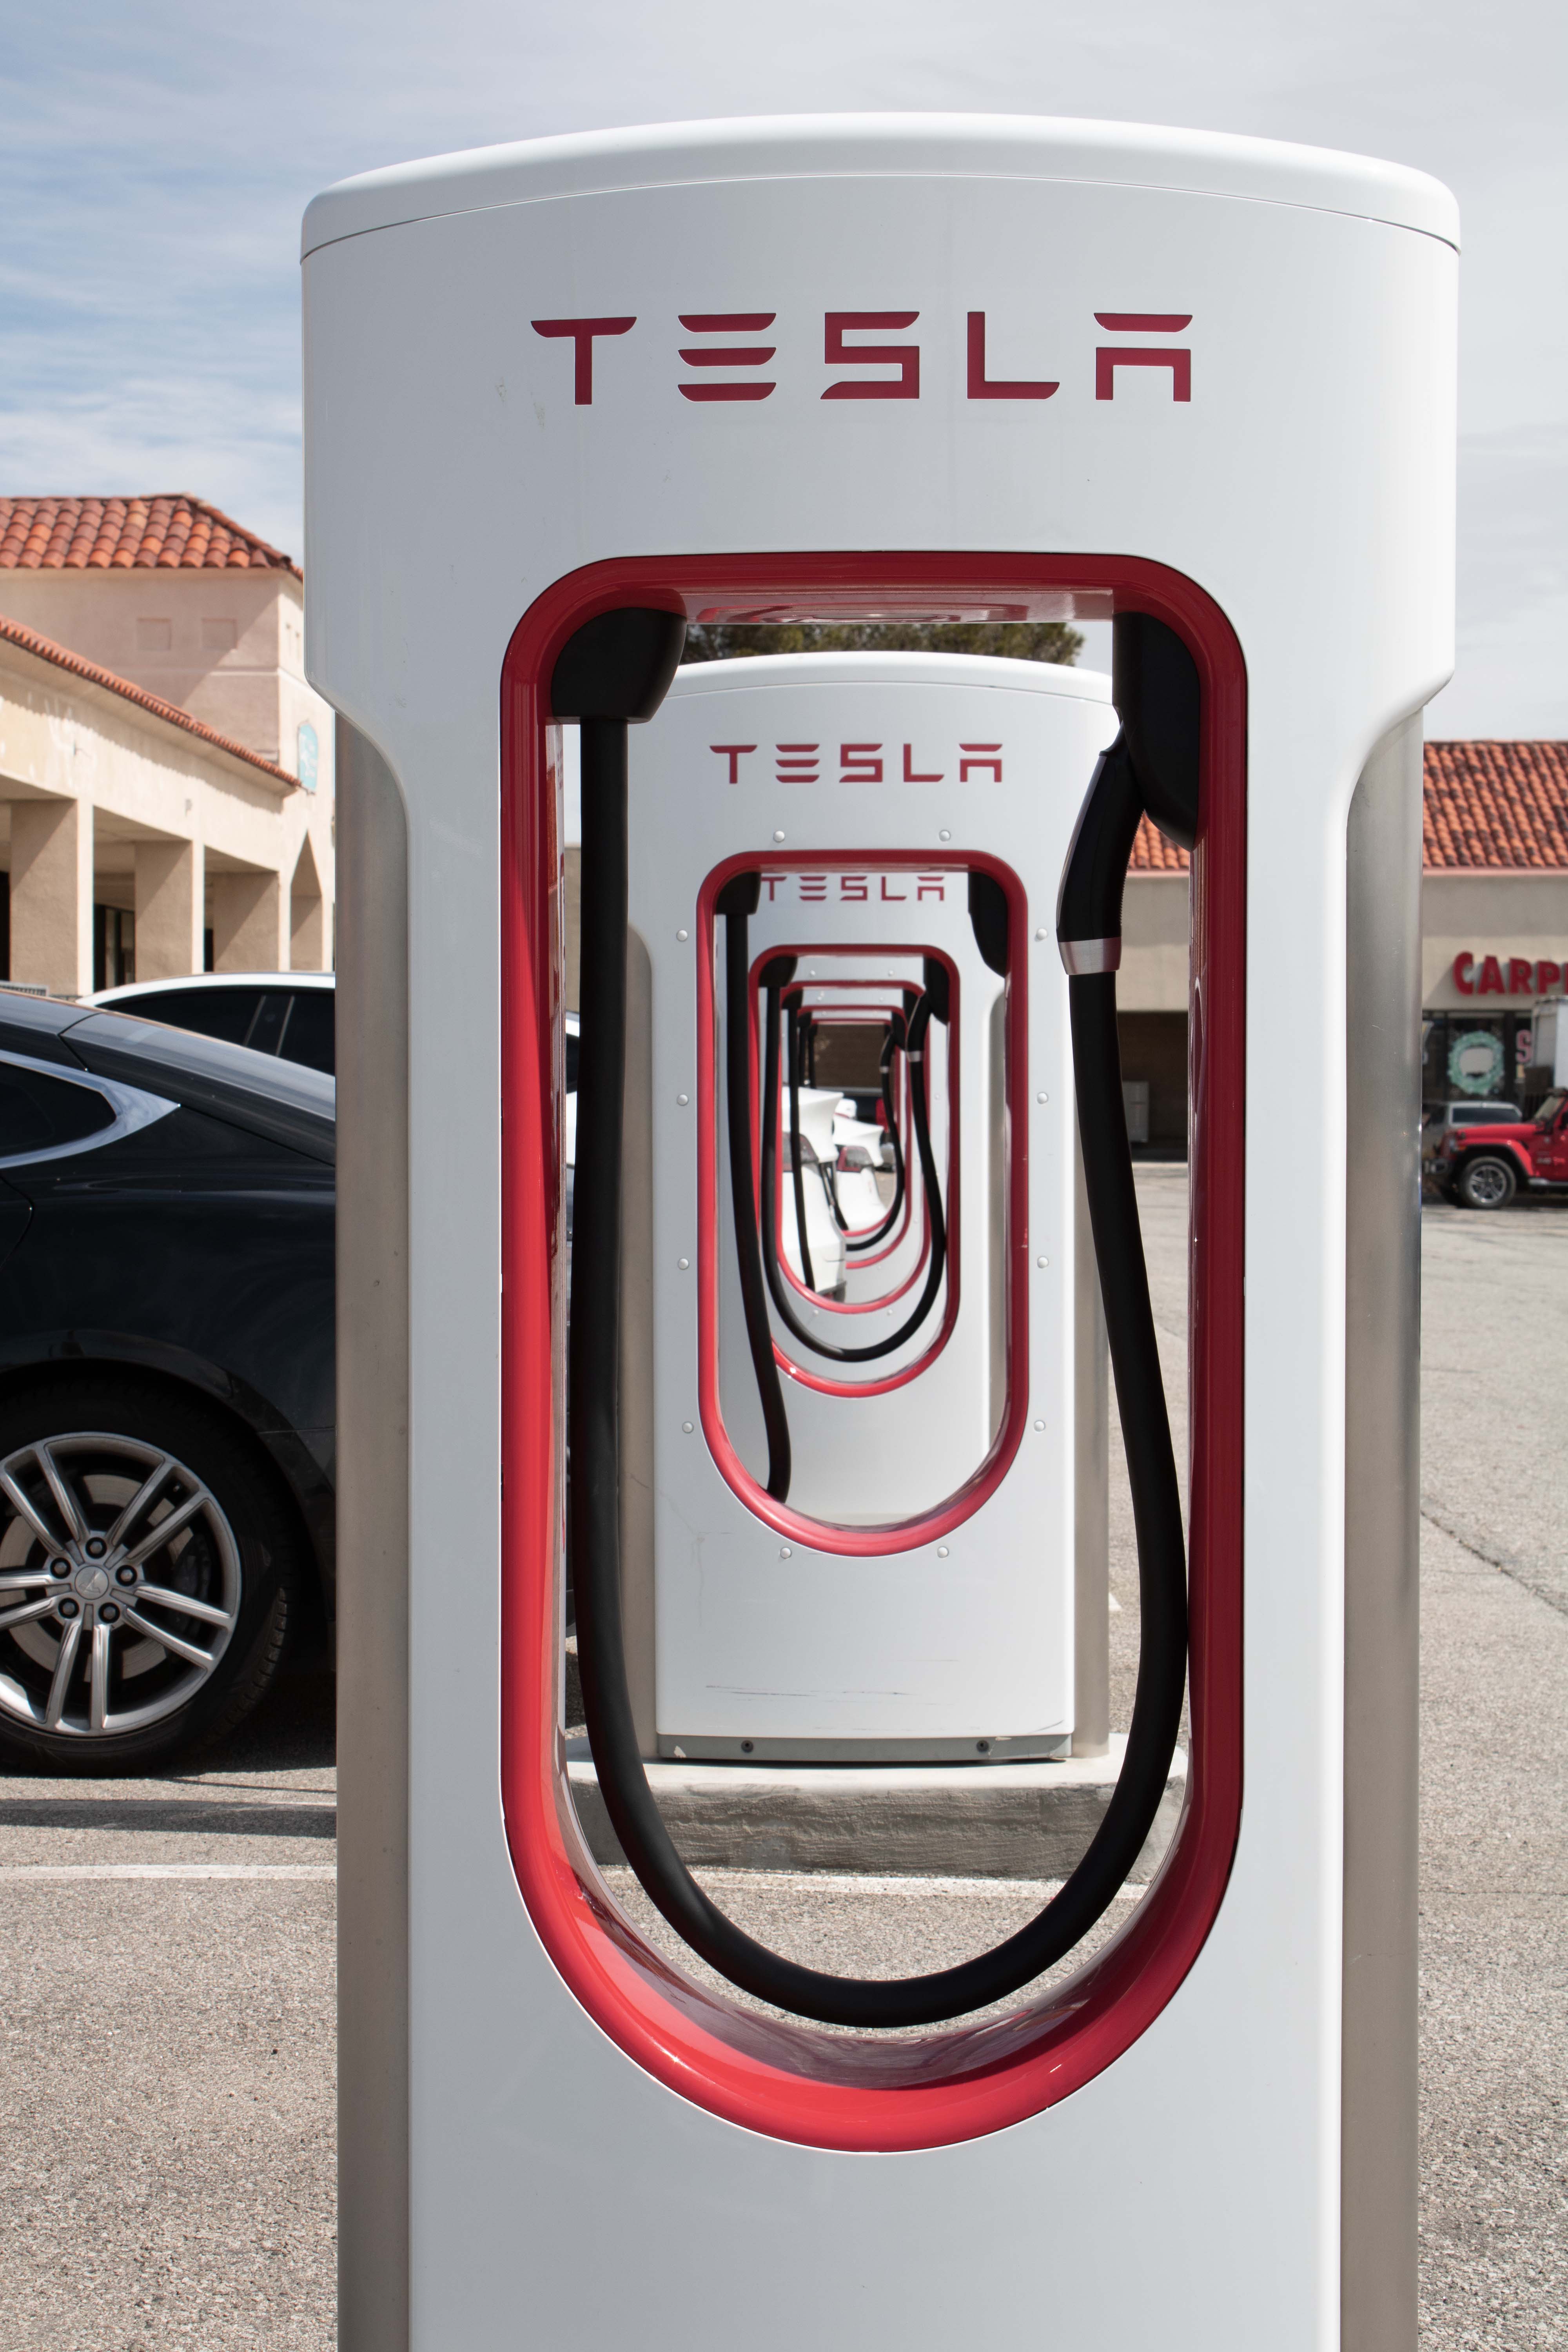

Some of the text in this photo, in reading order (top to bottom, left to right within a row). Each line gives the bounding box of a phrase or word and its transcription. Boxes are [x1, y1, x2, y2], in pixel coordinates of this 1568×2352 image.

[530, 312, 1193, 405] TESLA
[710, 743, 1002, 784] TESLA
[761, 876, 945, 901] TESLA
[1453, 951, 1568, 996] CARP
